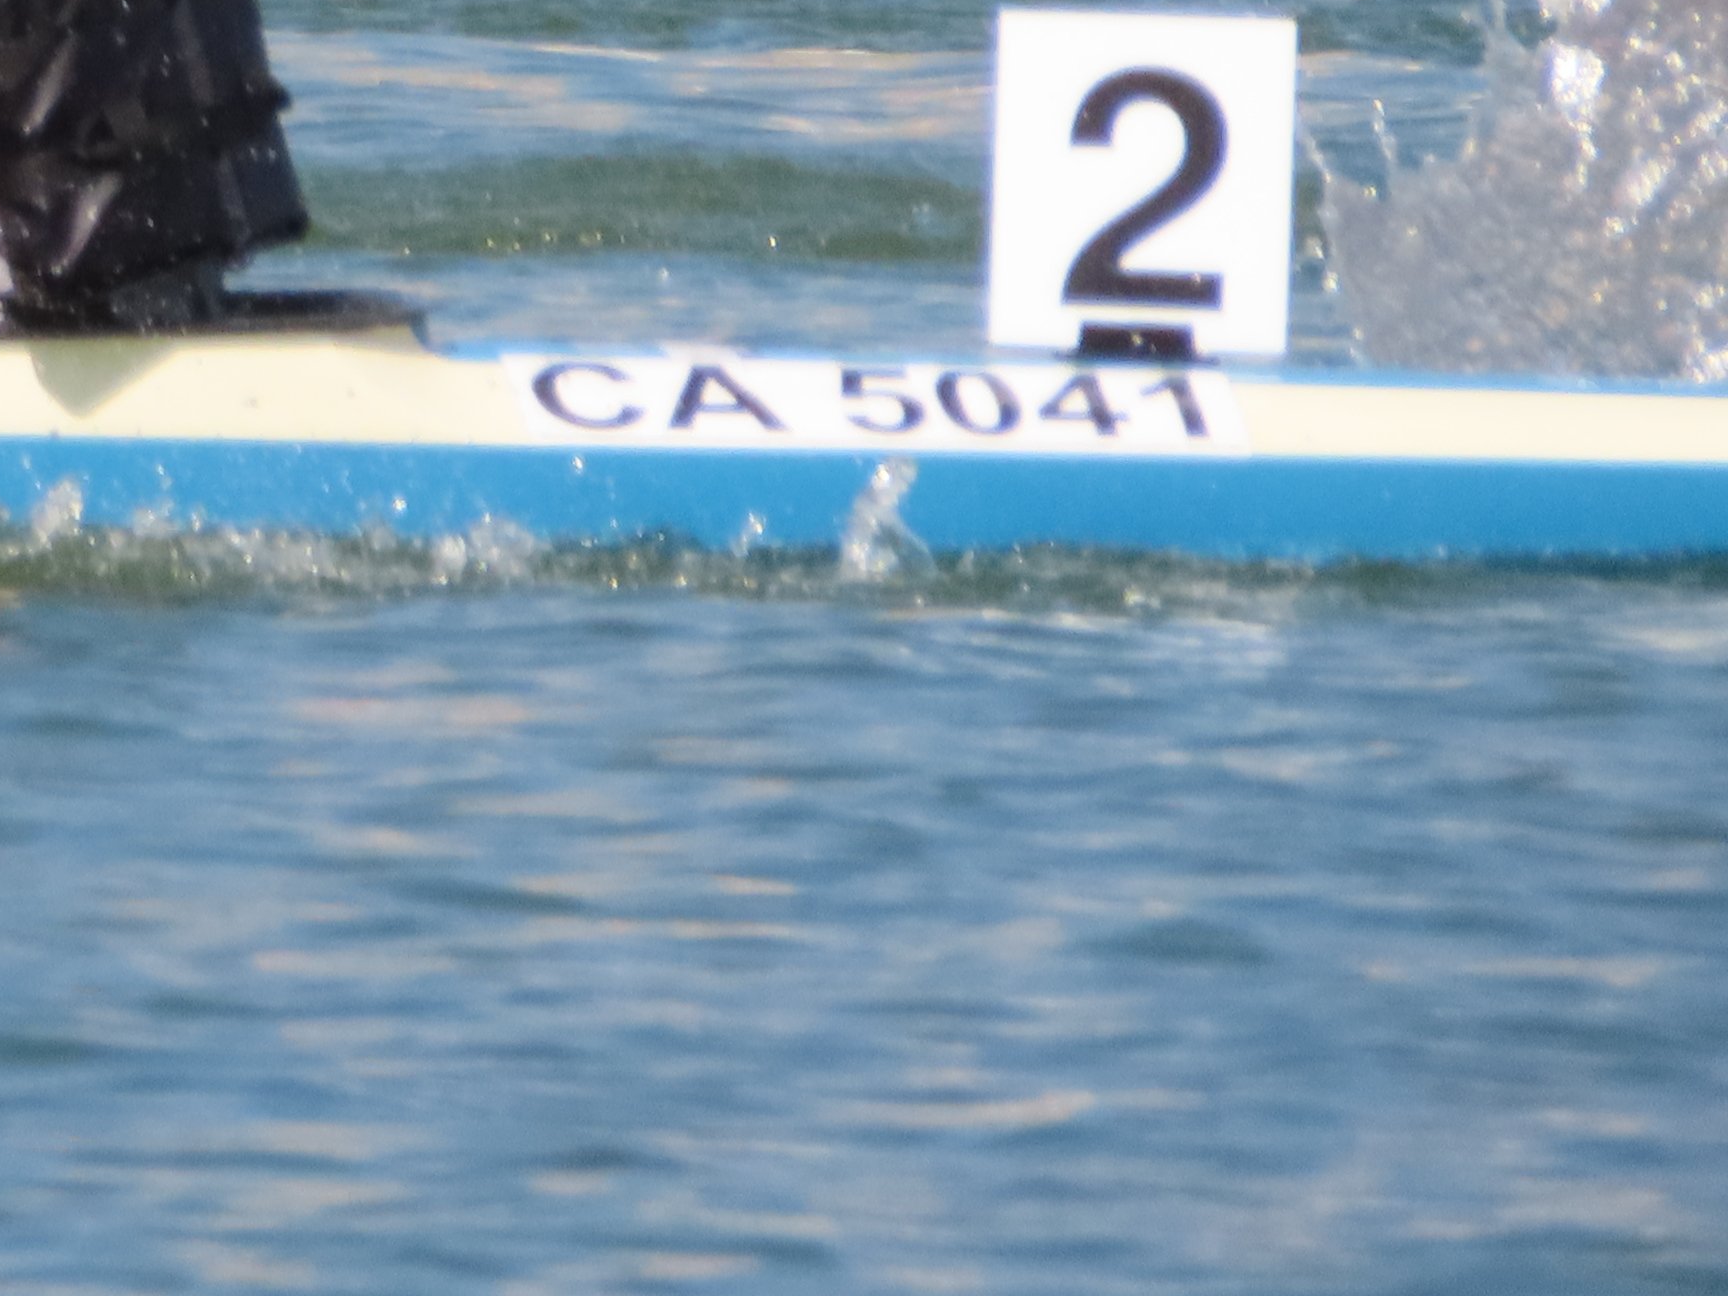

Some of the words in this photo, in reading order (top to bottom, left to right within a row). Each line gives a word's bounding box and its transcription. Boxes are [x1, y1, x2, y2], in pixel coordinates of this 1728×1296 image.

[1062, 63, 1229, 309] 2
[530, 360, 792, 433] CA
[838, 364, 1213, 439] 5041
